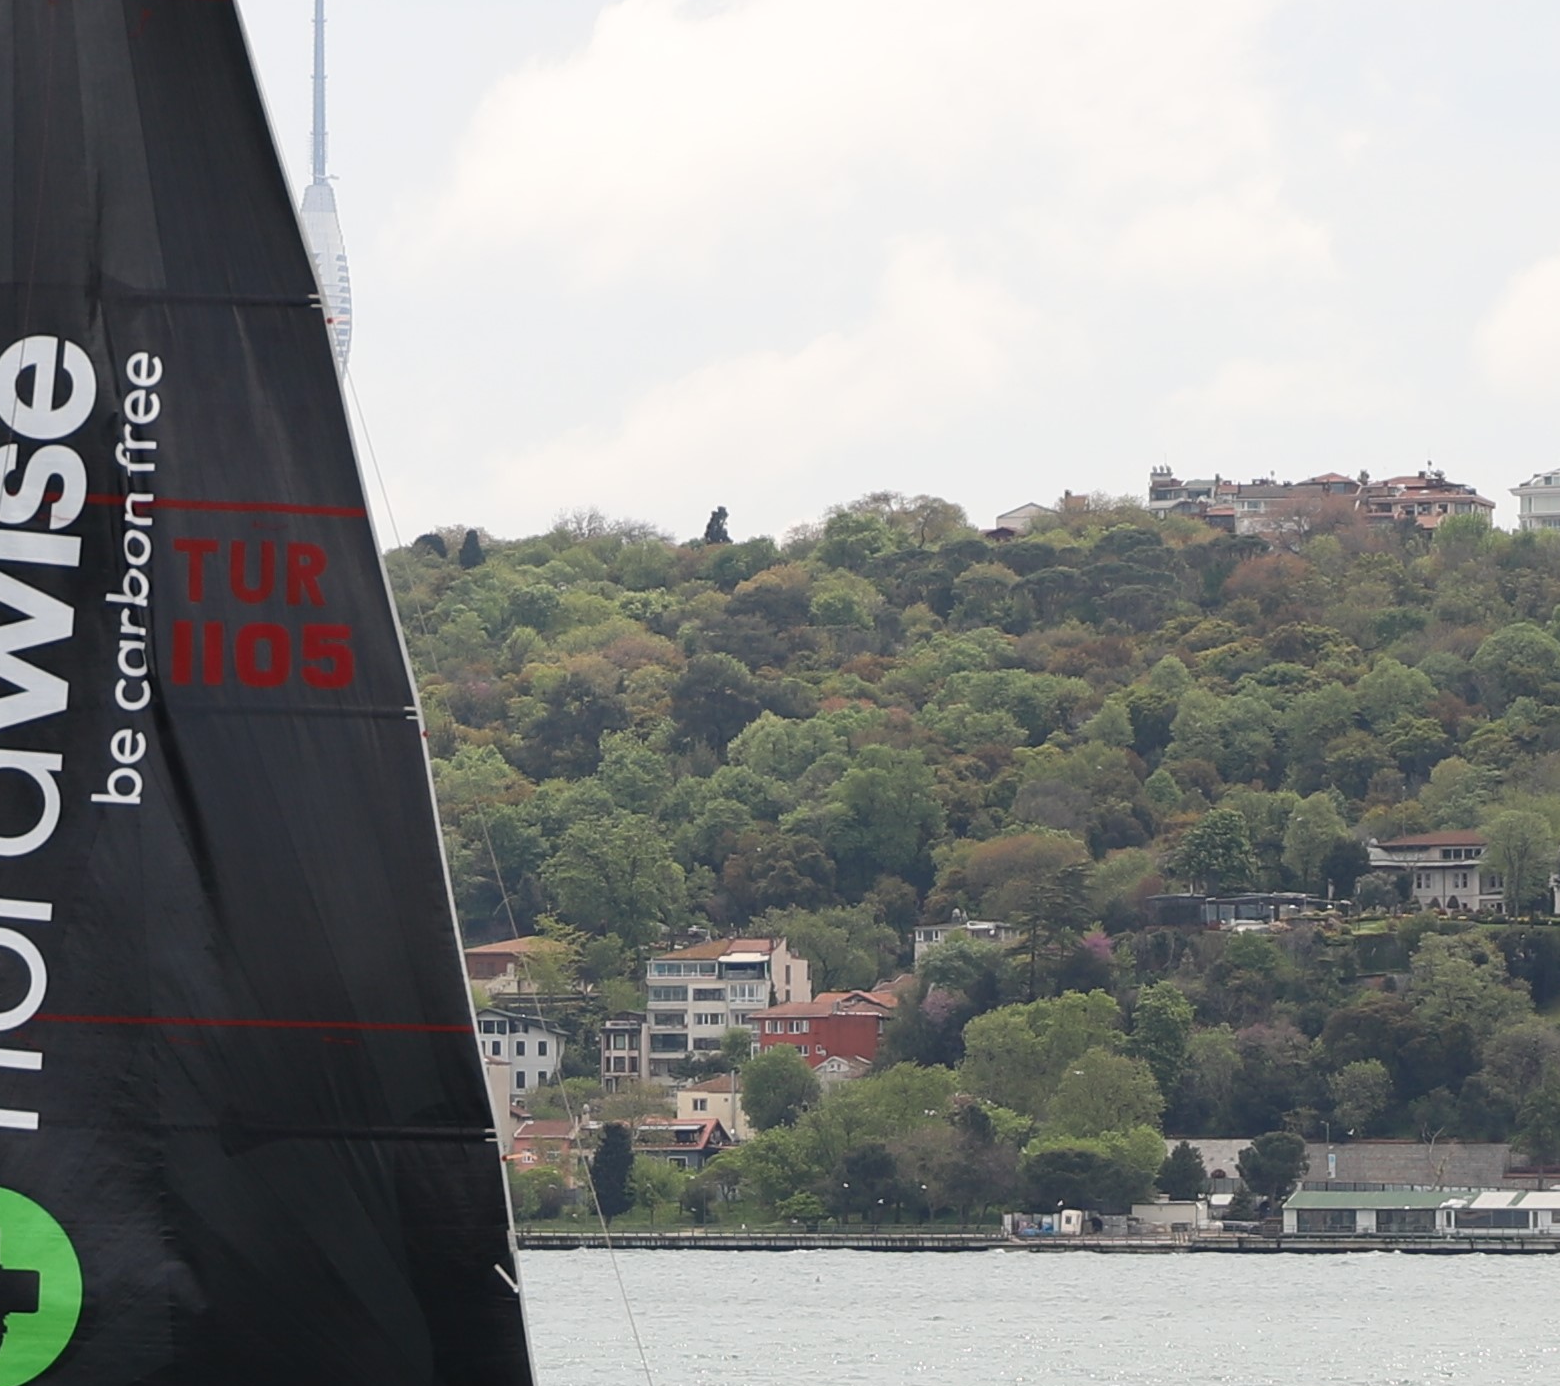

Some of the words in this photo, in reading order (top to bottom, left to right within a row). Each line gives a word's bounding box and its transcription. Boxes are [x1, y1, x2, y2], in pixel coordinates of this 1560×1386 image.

[115, 351, 163, 476] free
[105, 493, 154, 711] carbon
[173, 537, 329, 607] TUR
[171, 619, 355, 690] 1105
[91, 728, 146, 804] be
